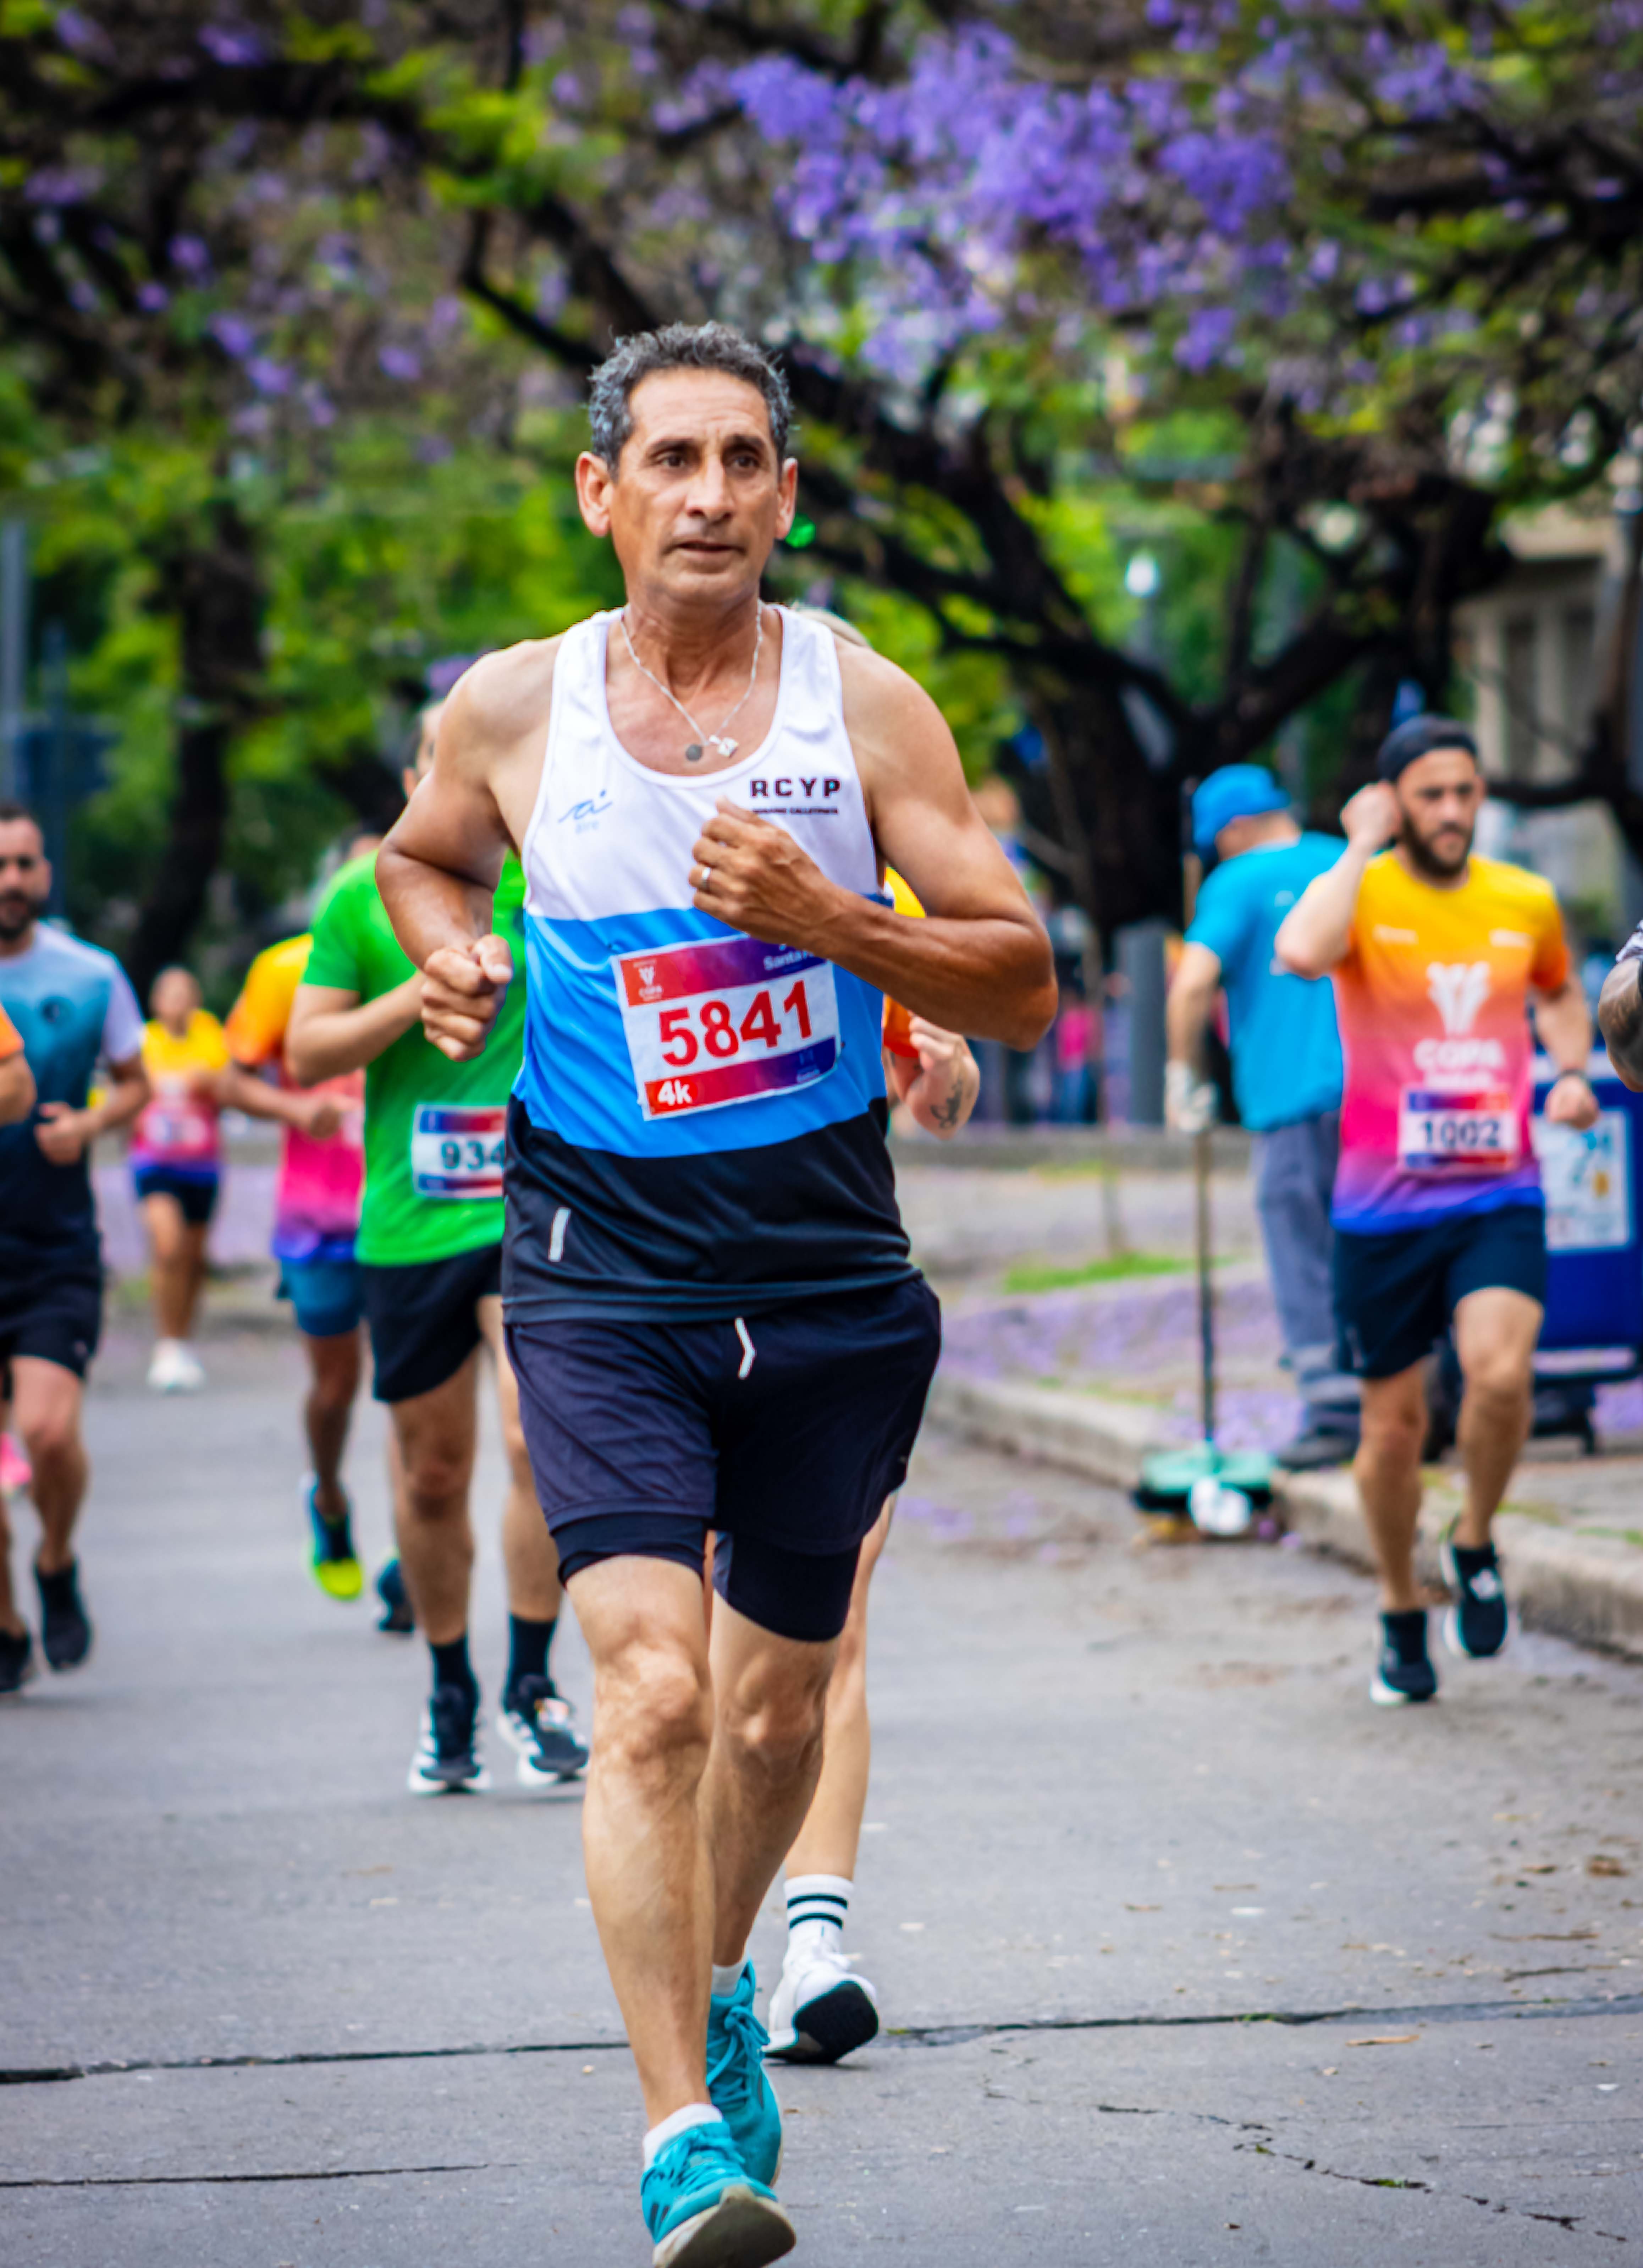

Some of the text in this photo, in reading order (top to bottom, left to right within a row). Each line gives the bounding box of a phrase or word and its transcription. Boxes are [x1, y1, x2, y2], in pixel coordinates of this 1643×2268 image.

[750, 778, 840, 797] RCYP
[659, 979, 812, 1067] 5841
[658, 1079, 692, 1106] 4k
[1419, 1120, 1501, 1148] 1002
